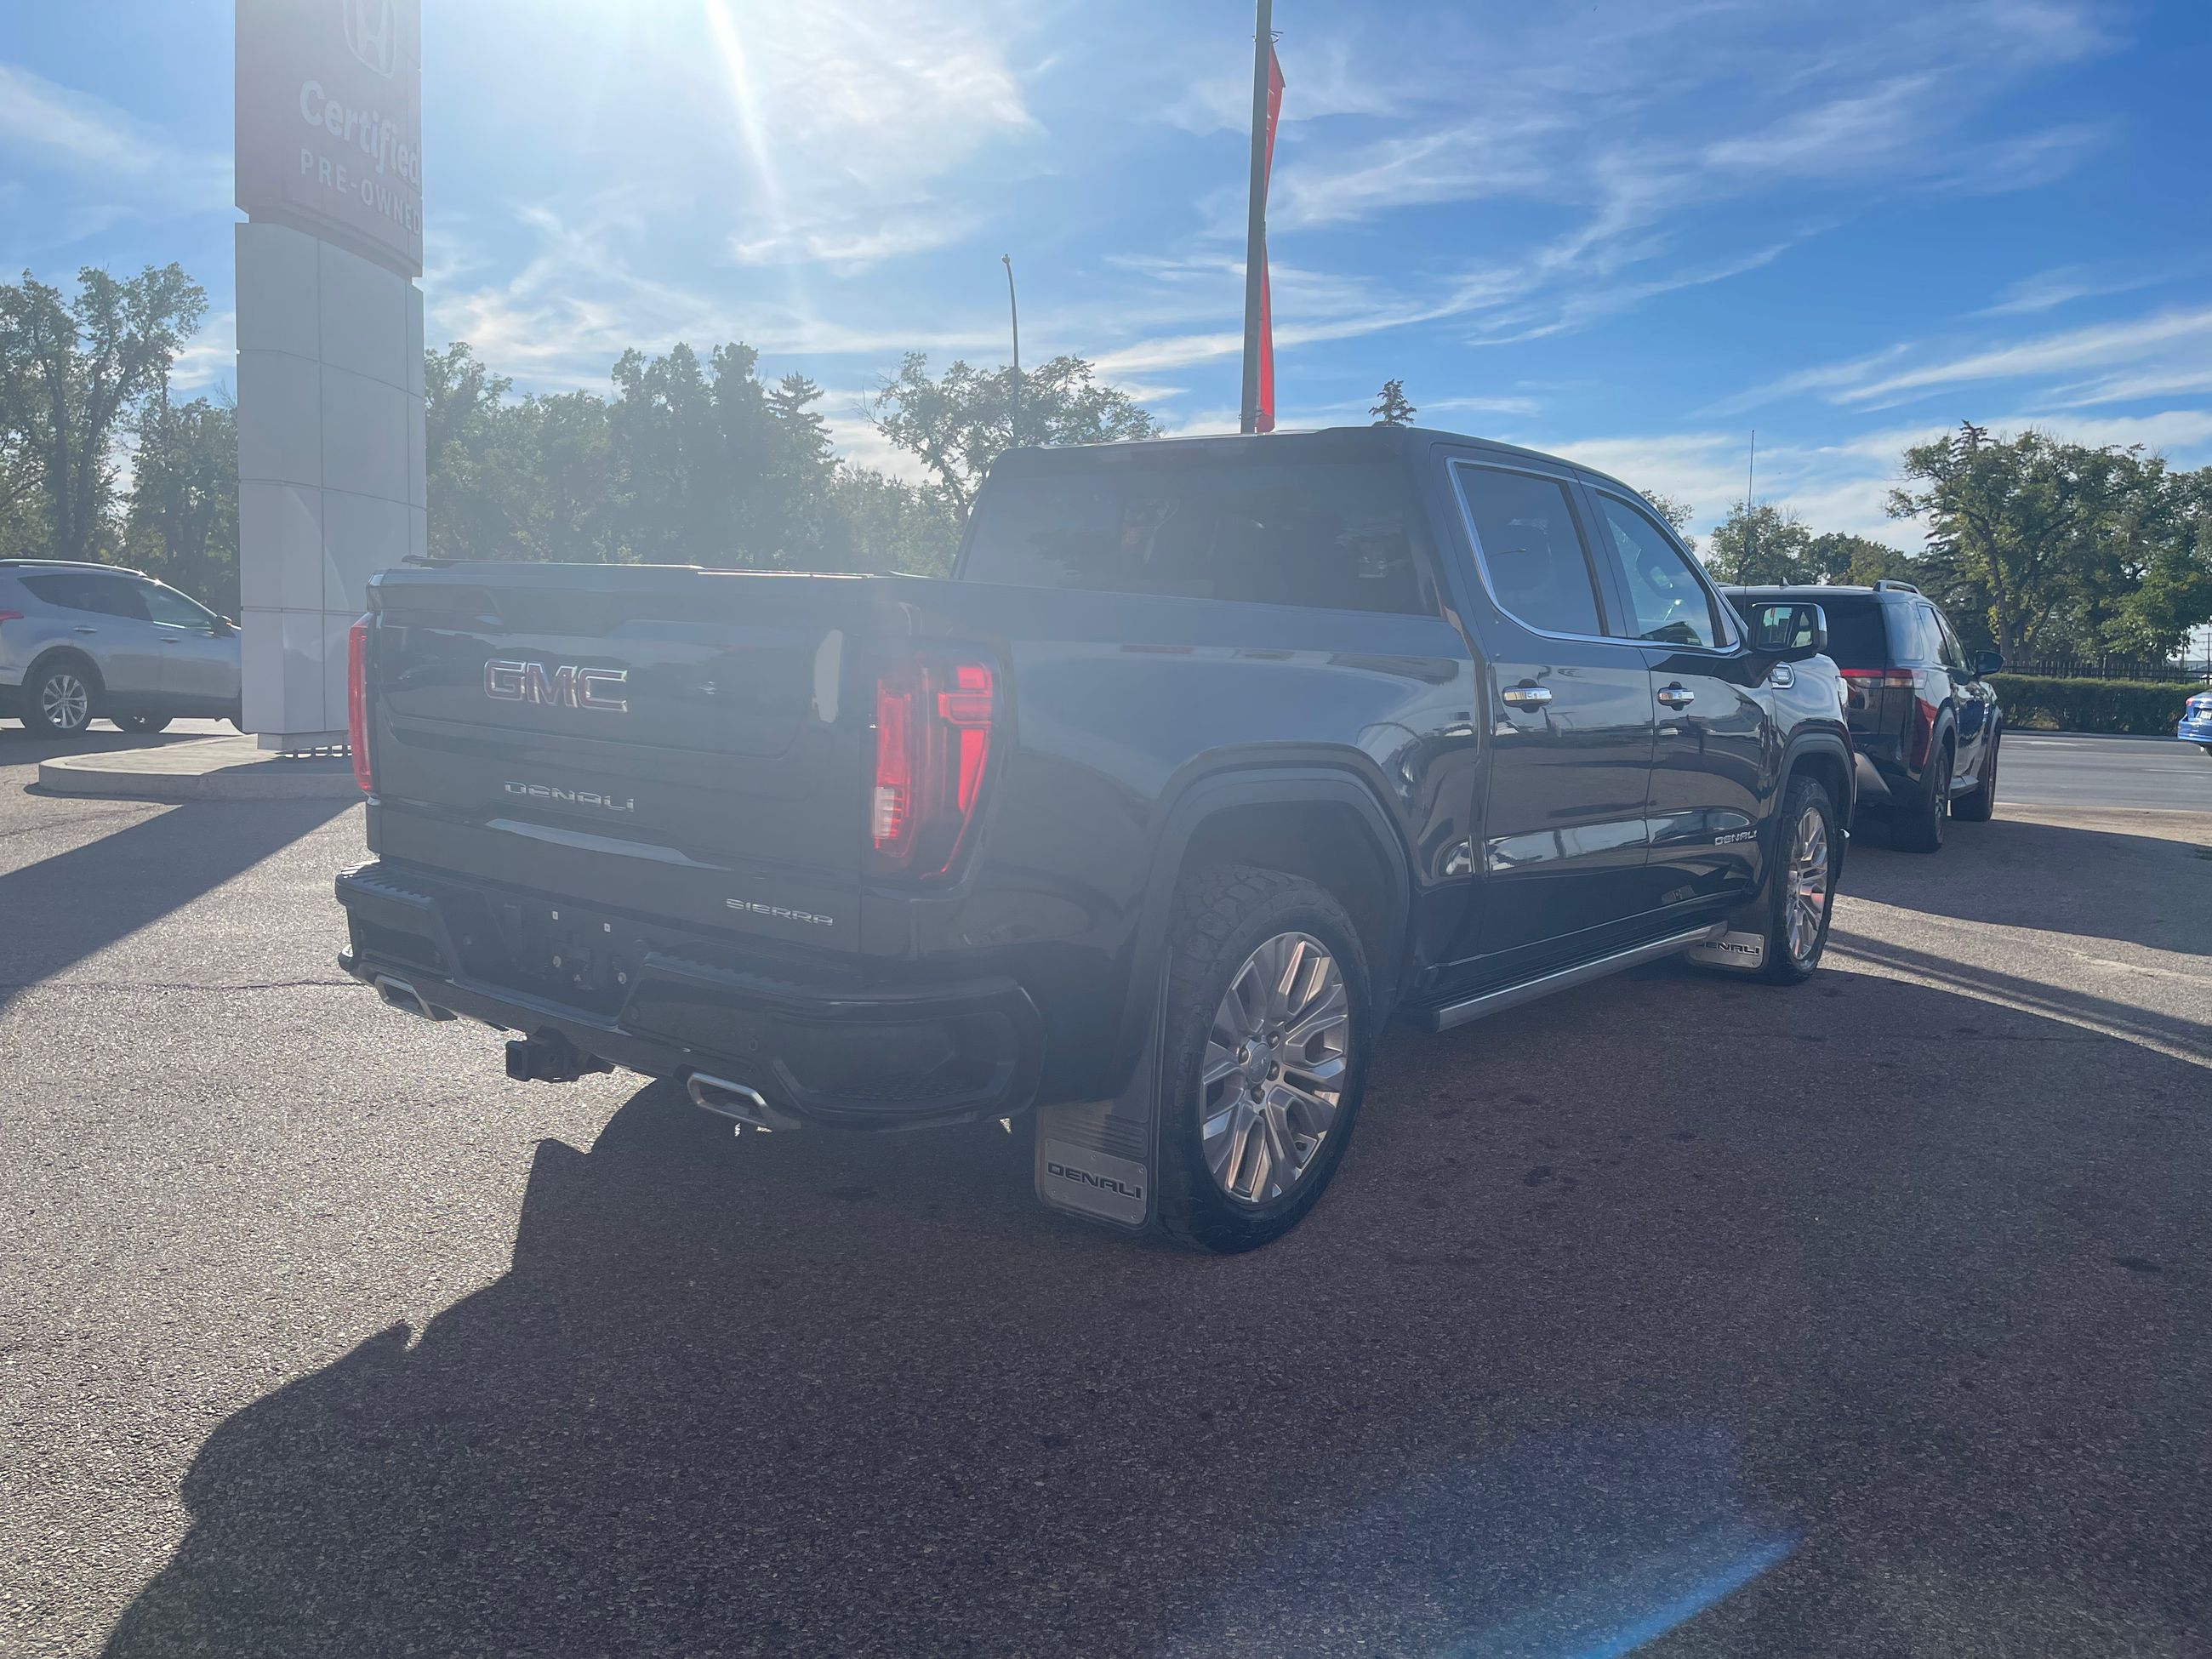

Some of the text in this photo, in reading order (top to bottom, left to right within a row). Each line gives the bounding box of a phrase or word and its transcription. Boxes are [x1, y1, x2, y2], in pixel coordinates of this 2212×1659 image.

[299, 80, 420, 185] Certified
[300, 148, 421, 236] PRE-OWNED
[484, 658, 628, 712] GMC
[505, 781, 634, 812] DENALI
[1714, 830, 1758, 846] DENALI
[726, 898, 833, 926] SIERRA
[1698, 941, 1760, 955] ENALI
[1046, 1160, 1143, 1200] DENALI
